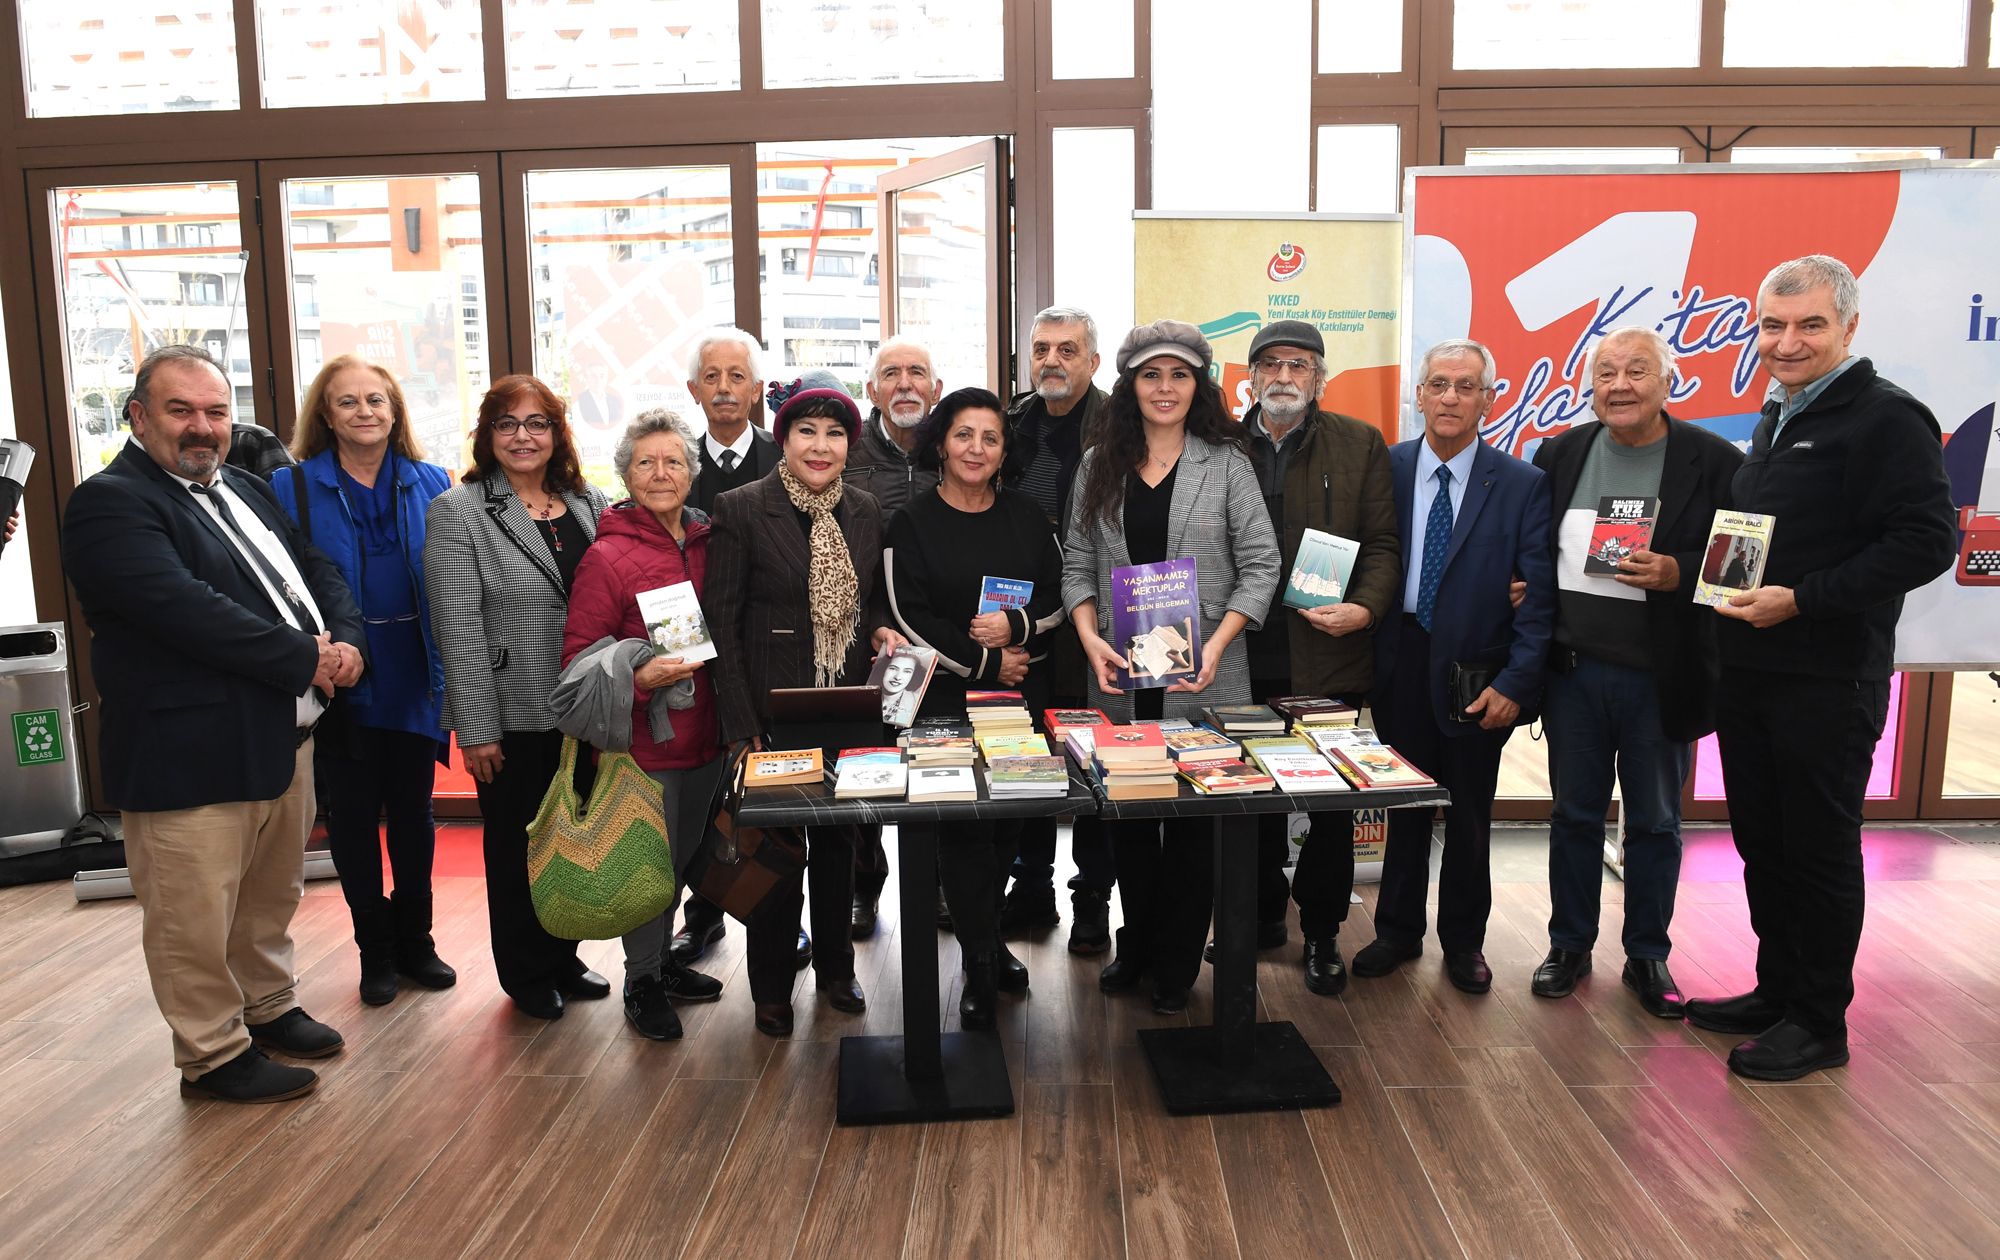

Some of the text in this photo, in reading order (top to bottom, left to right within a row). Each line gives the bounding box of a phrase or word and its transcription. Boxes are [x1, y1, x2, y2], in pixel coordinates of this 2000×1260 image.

[1268, 294, 1300, 306] YKKED
[1268, 309, 1397, 321] Yeni Kuşak Köy Enstitüler Derneği
[1319, 322, 1364, 333] Katkılarıyla
[1612, 504, 1644, 514] TUZ
[1724, 518, 1744, 526] ABİDİN
[1123, 570, 1190, 587] YAŞANMAMIŞ
[1132, 582, 1186, 596] MEKTUPLAR
[649, 599, 668, 608] yeniden
[668, 594, 686, 603] doğmak
[1126, 598, 1190, 612] BELGÜN BİLGEMAN
[26, 716, 47, 726] CAM
[30, 751, 52, 760] GLASS
[752, 752, 812, 760] OYUNLAR
[1353, 809, 1385, 824] KAN
[1354, 826, 1381, 841] DIN
